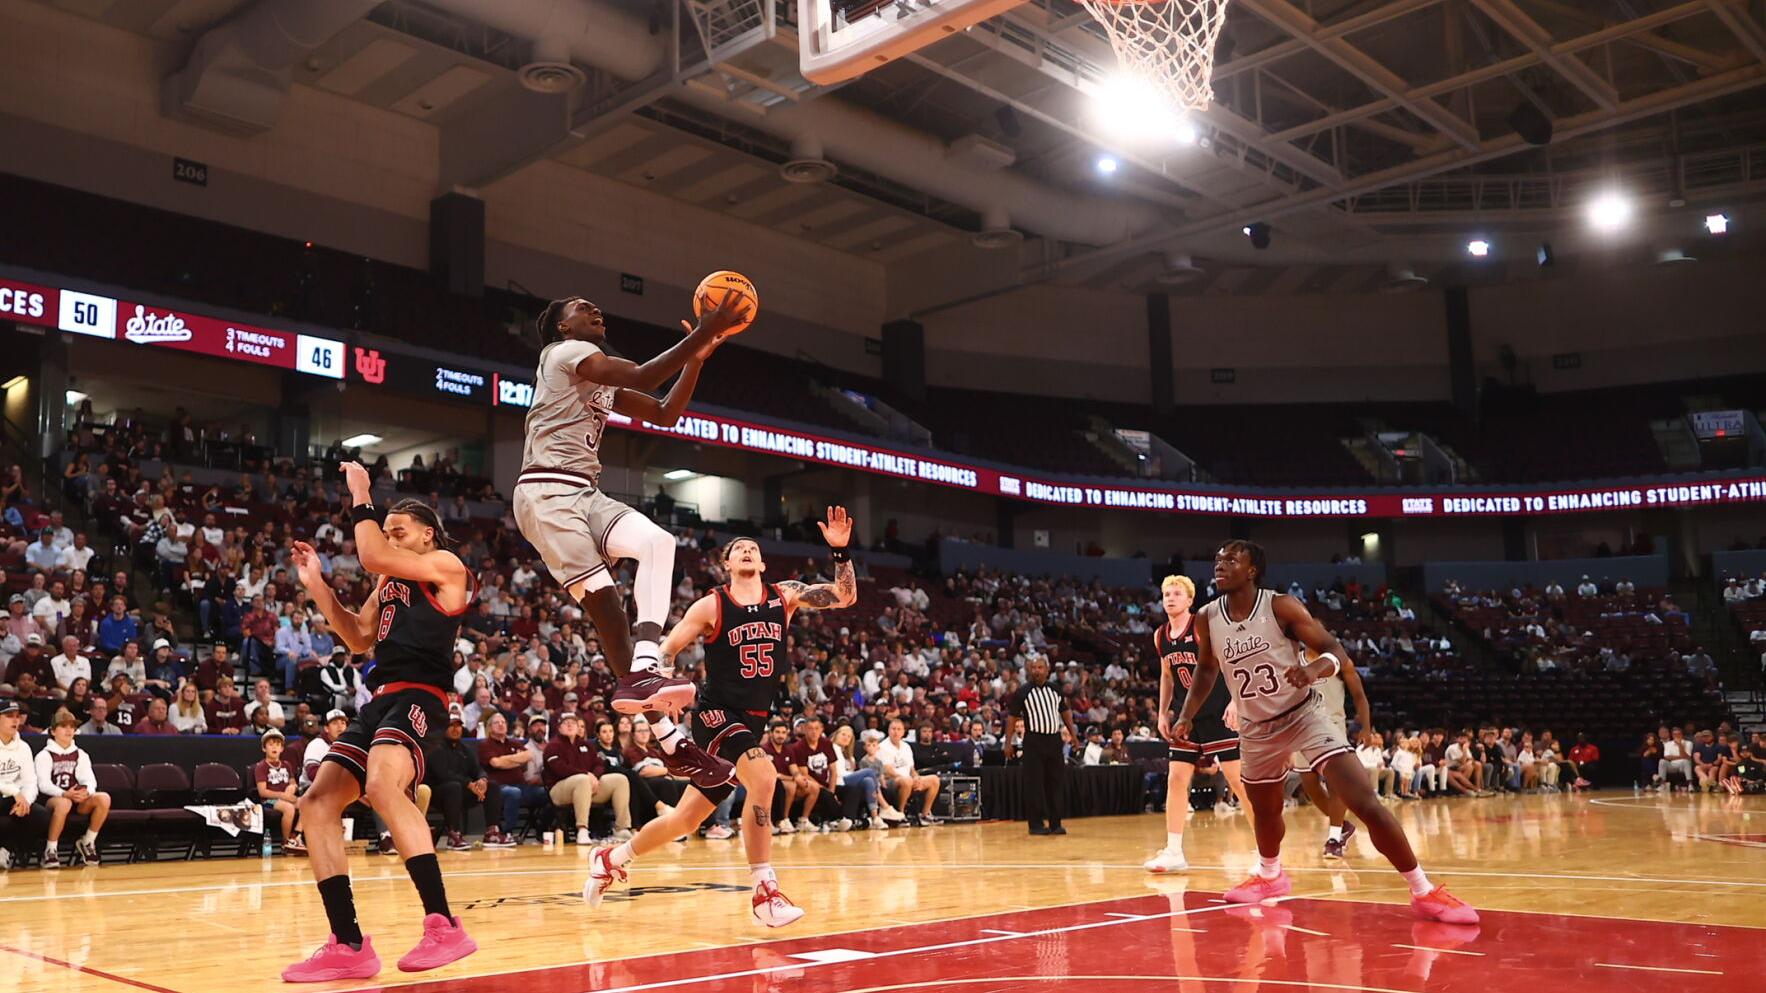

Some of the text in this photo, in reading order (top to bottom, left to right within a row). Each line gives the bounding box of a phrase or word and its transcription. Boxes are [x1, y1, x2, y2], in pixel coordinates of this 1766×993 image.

[177, 163, 206, 181] 206
[0, 287, 44, 317] CES
[74, 301, 98, 326] 50
[125, 304, 191, 342] State
[236, 330, 285, 349] TIMEOUTS
[237, 343, 270, 357] FOULS
[311, 347, 332, 369] 46
[443, 369, 484, 386] TIMEOUTS
[443, 381, 471, 395] FOULS
[720, 424, 739, 443] TO
[742, 428, 814, 457] ENHANCING
[816, 441, 917, 477] STUDENT-ATHLETE
[918, 461, 977, 487] RESOURCES
[1025, 482, 1082, 503] DEDICATED
[1085, 488, 1101, 504] TO
[1104, 490, 1175, 509] ENHANCING
[1177, 493, 1282, 515] STUDENT-ATHLETE
[1285, 499, 1367, 515] RESOURCES
[1443, 497, 1520, 512] DEDICATED
[1524, 497, 1543, 511] TO
[1548, 490, 1641, 510] ENHANCING
[378, 605, 396, 641] 8
[728, 621, 782, 646] UTAH
[740, 643, 774, 679] 55
[1223, 634, 1268, 663] State
[1177, 667, 1193, 689] 0
[1233, 664, 1281, 700] 23
[117, 711, 132, 725] 13
